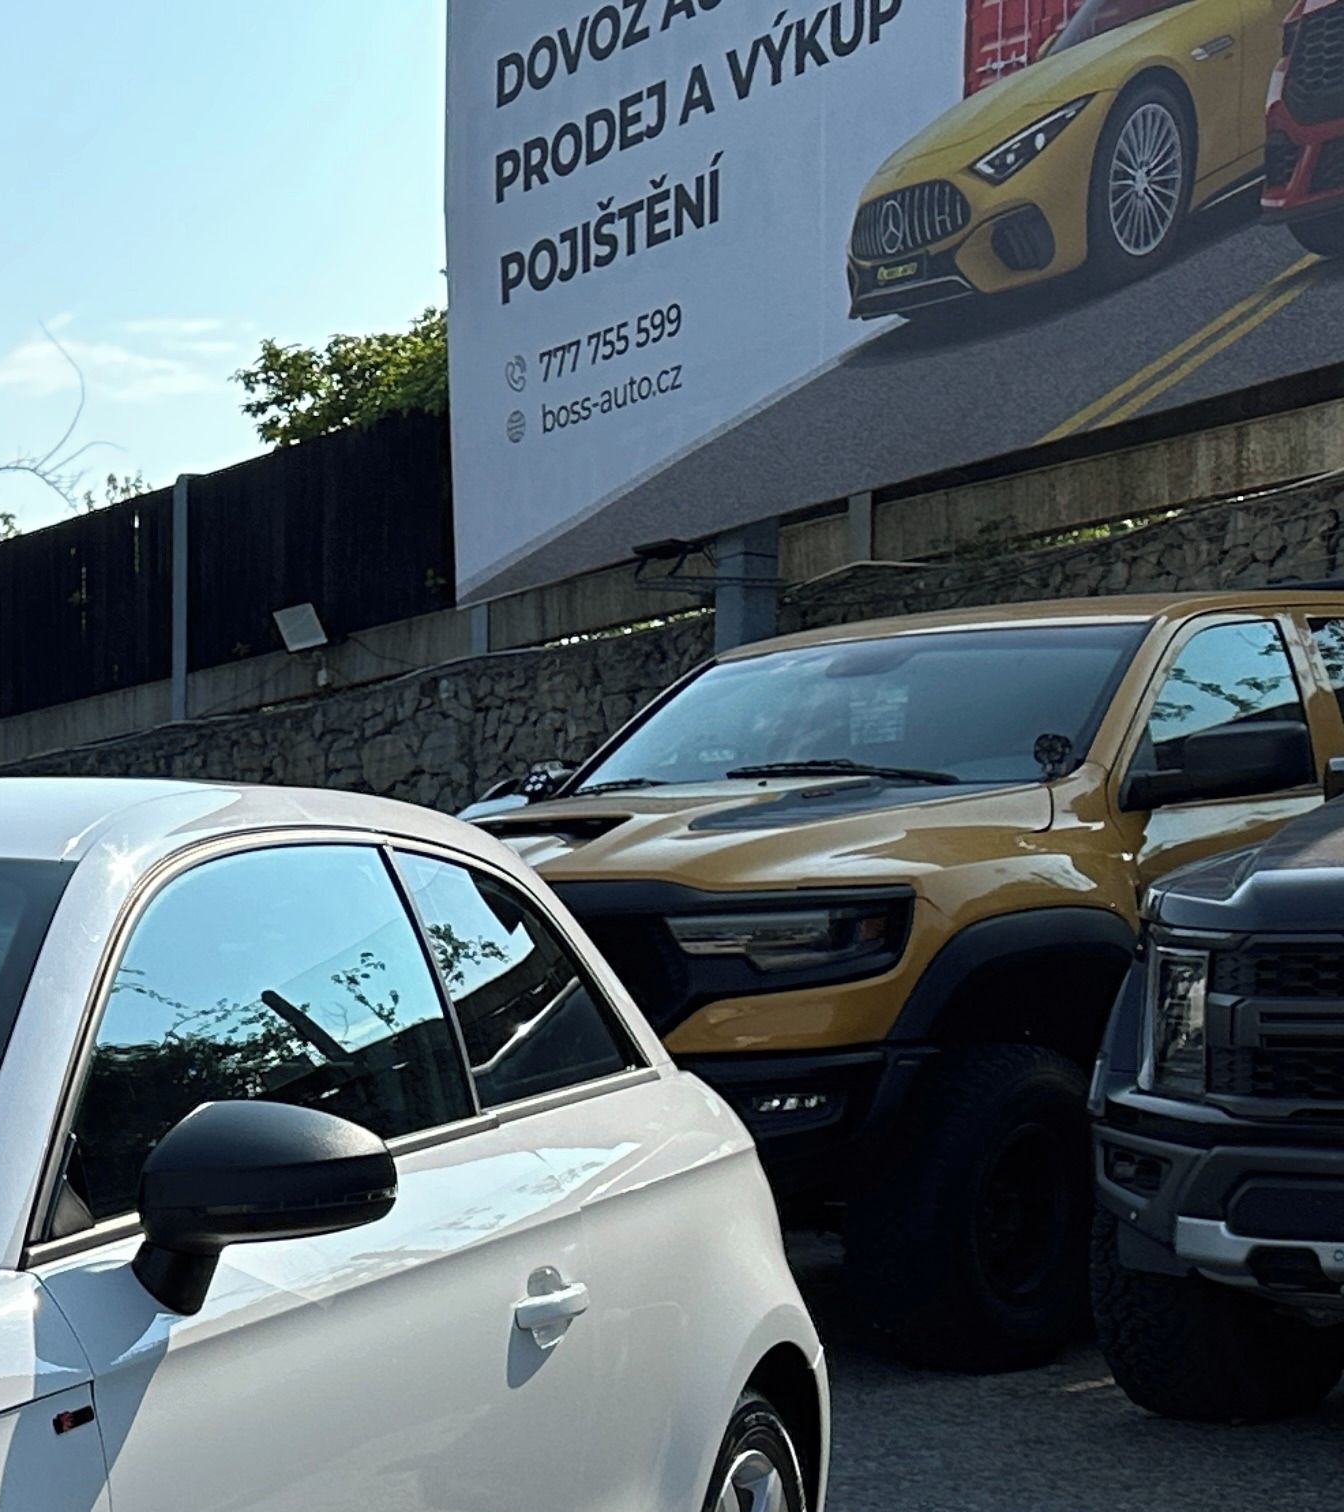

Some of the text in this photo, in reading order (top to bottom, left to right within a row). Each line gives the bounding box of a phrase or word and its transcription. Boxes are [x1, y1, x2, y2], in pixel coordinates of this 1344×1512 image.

[495, 0, 903, 204] PRODEJ A VÝKUP
[496, 0, 650, 108] DOVOZ
[500, 150, 725, 305] POJIŠTĚNÍ
[539, 303, 681, 383] 777 755 599
[542, 364, 683, 434] boss-auto.cz
